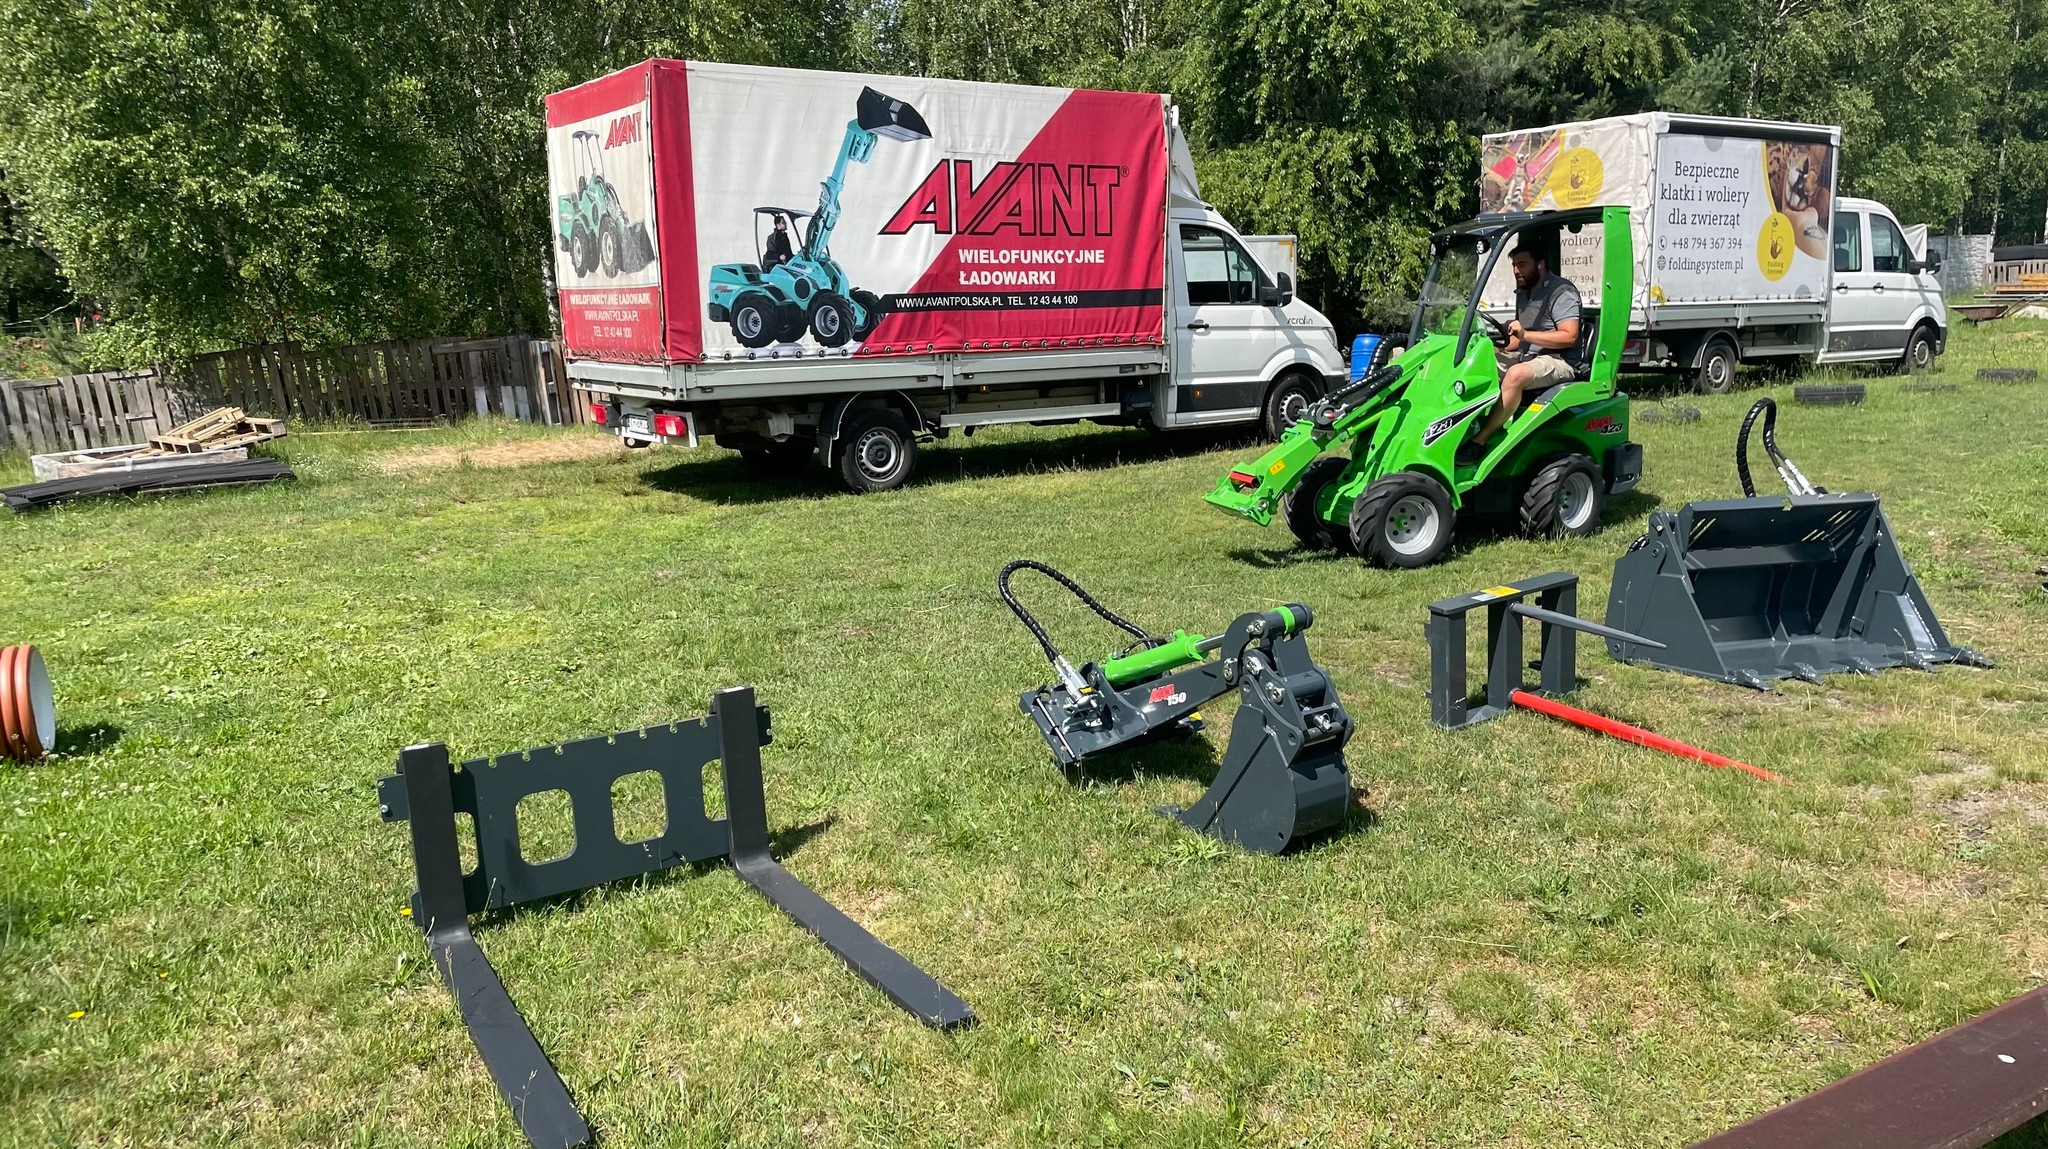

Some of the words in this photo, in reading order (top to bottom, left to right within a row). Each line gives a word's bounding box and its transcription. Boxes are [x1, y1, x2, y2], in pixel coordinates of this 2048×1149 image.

[604, 111, 642, 150] AVANT
[1674, 160, 1740, 183] Bezpieczne
[1660, 182, 1695, 201] klatki
[1698, 186, 1702, 201] i
[1706, 185, 1750, 209] woliery
[1668, 207, 1687, 225] dla
[1691, 210, 1740, 229] zwierząt
[1672, 236, 1689, 249] +48
[1691, 237, 1707, 250] 794
[1709, 237, 1725, 250] 367
[1727, 237, 1743, 250] 394
[958, 248, 1105, 264] WIELOFUNKCYJNE
[1668, 256, 1744, 275] foldingsystem.pl
[959, 271, 1056, 285] ŁADOWARKI
[570, 293, 618, 305] WIELOFUNKCYJNE
[895, 296, 1004, 308] WWW.AVANTPOLSKA.PL
[1007, 296, 1026, 306] TEL.
[1028, 296, 1038, 306] 12
[1039, 296, 1050, 305] 43
[1051, 296, 1062, 305] 44
[1063, 295, 1079, 305] 100
[623, 327, 632, 338] 100
[1600, 423, 1623, 435] 423
[1167, 691, 1187, 706] 150
